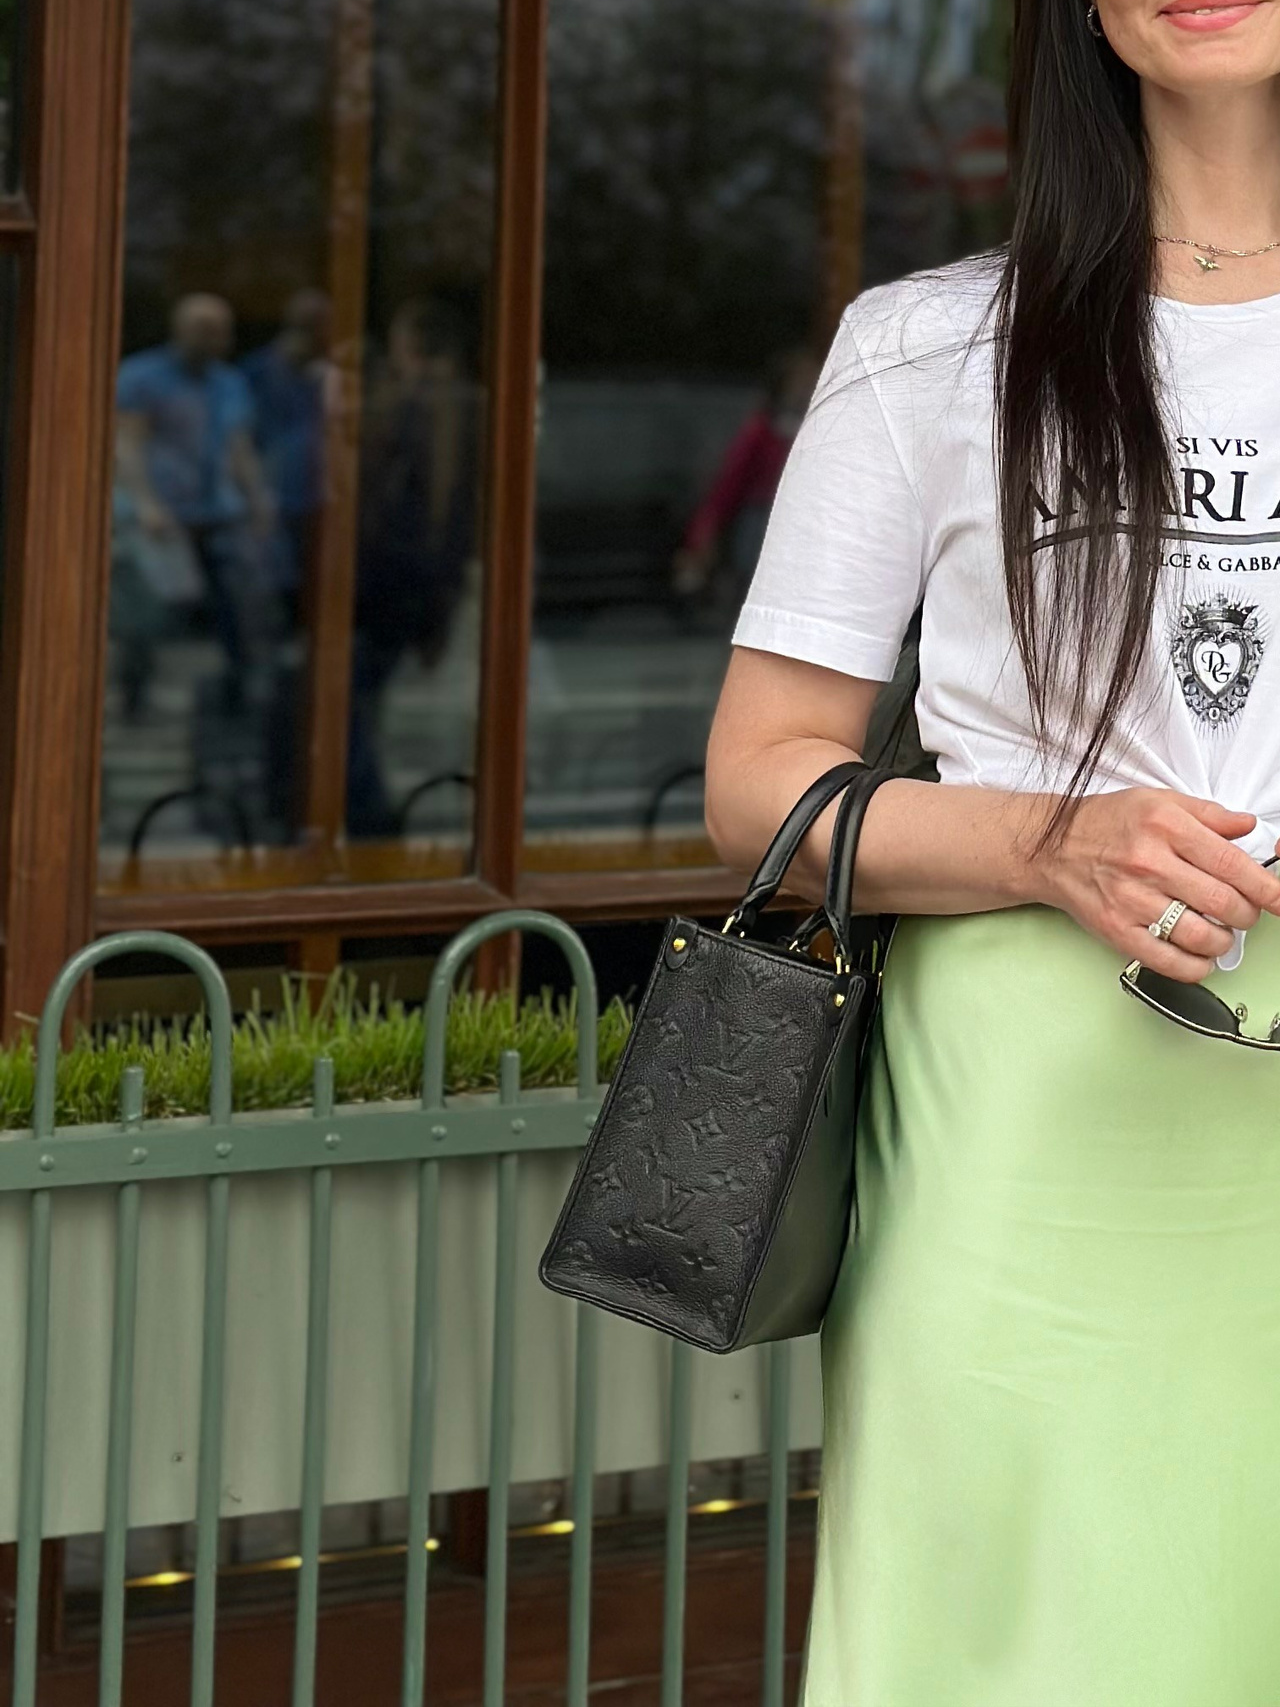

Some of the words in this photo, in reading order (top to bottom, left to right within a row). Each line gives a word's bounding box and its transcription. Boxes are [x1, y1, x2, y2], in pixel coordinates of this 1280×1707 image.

[1176, 436, 1200, 454] SI
[1208, 437, 1259, 457] VIS
[1024, 461, 1249, 522] AMRI
[1197, 553, 1211, 571] &
